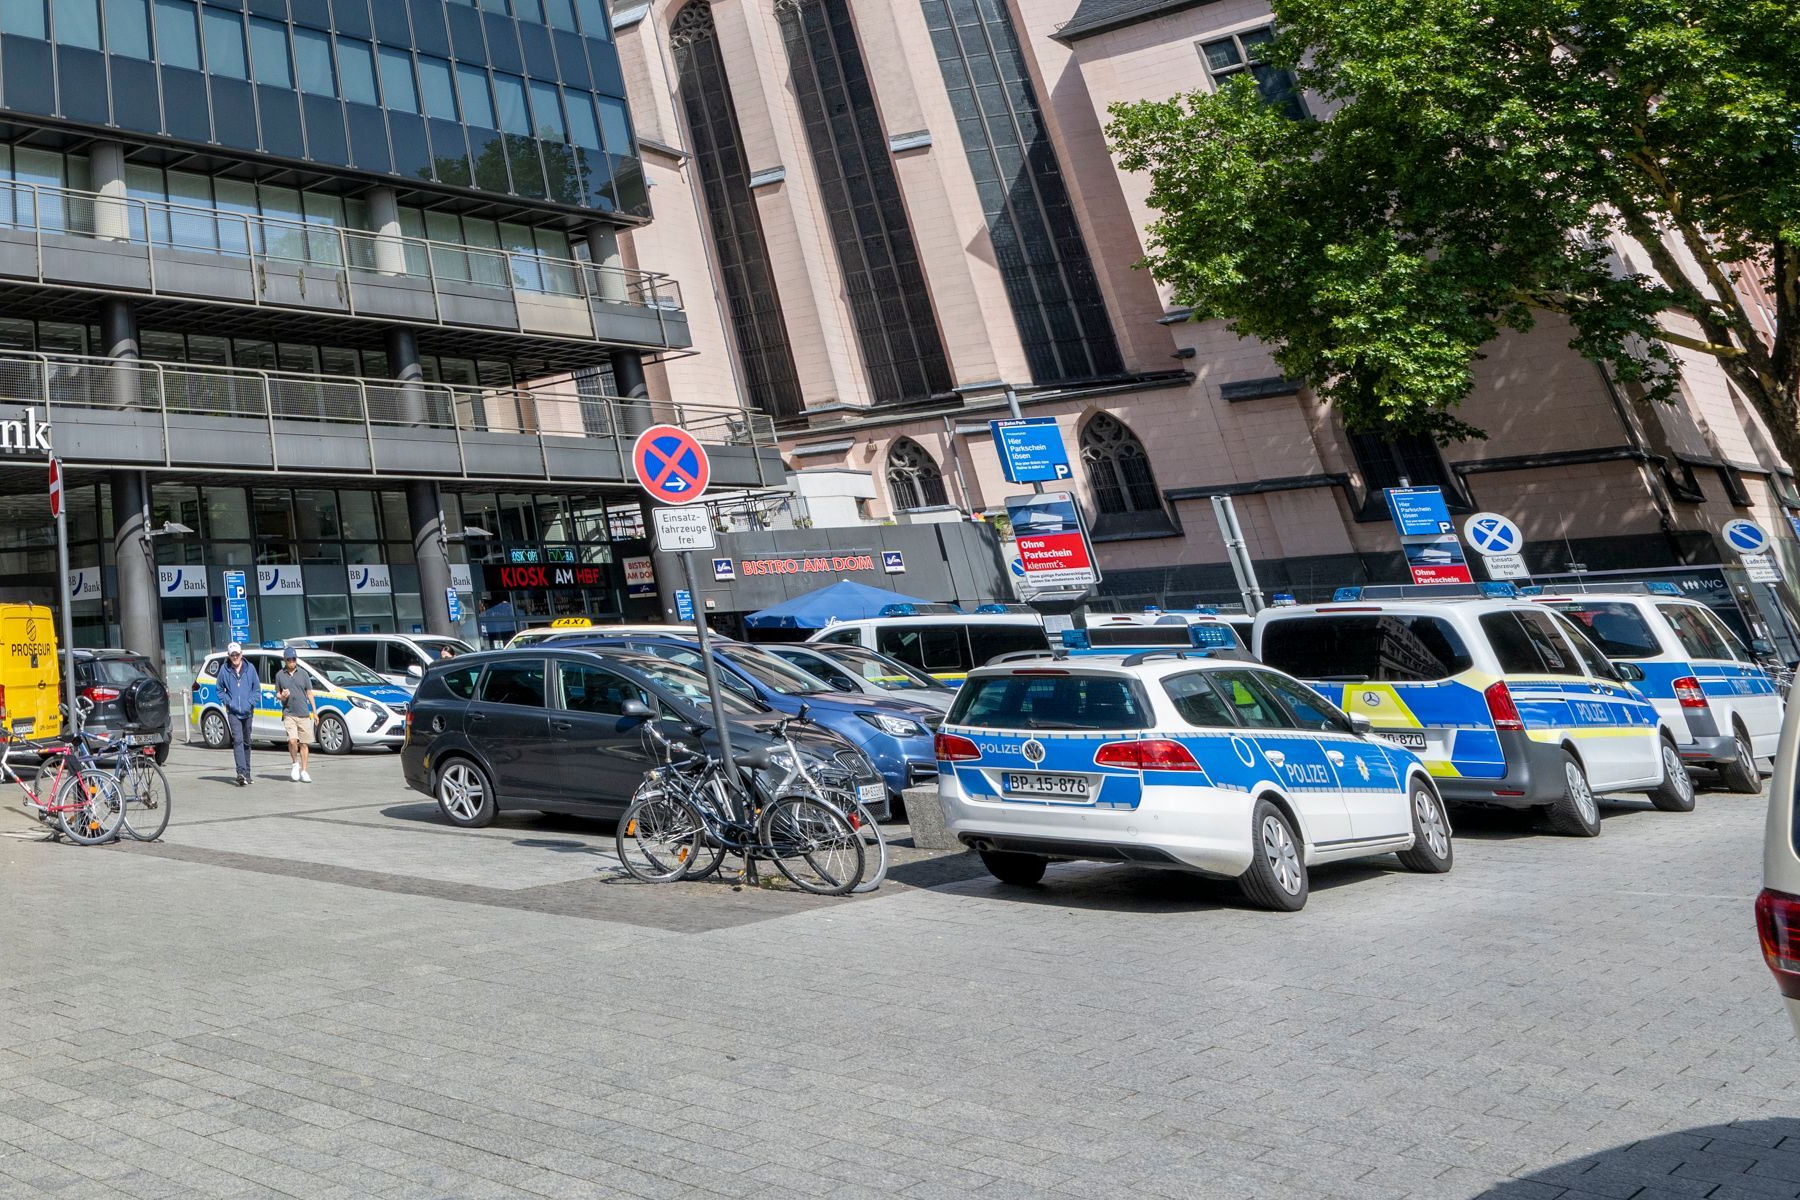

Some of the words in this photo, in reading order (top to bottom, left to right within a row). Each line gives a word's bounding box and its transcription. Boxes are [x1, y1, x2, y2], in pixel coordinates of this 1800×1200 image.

[1009, 444, 1047, 452] Parkschein
[1054, 464, 1068, 480] P
[662, 513, 701, 523] Einsatz-
[661, 524, 707, 536] fahrzeuge
[1439, 522, 1451, 534] P
[678, 535, 695, 544] frei
[1020, 540, 1046, 550] Ohne
[1023, 547, 1073, 560] Parkschein
[627, 561, 650, 570] BISTRO
[741, 558, 799, 575] BISTRO
[802, 557, 830, 573] AM
[831, 555, 874, 571] DOM
[1026, 559, 1067, 571] klemmt's.
[160, 571, 173, 582] BB
[259, 571, 271, 580] BB
[350, 570, 361, 580] BB
[500, 566, 549, 588] KIOSK
[555, 568, 575, 585] AM
[575, 567, 600, 584] HBF
[627, 572, 638, 580] AM
[183, 579, 206, 590] Bank
[280, 579, 302, 588] Bank
[370, 577, 389, 587] Bank
[453, 576, 472, 586] Bank
[1700, 579, 1723, 589] WC
[83, 582, 101, 593] Bank
[236, 586, 245, 599] P
[11, 643, 51, 656] PROSEGUR
[1575, 703, 1608, 722] POLIZEI
[980, 743, 1022, 755] POLIZEI
[1285, 763, 1330, 783] POLIZEI
[1011, 775, 1029, 790] BP
[1036, 776, 1086, 793] 15-876
